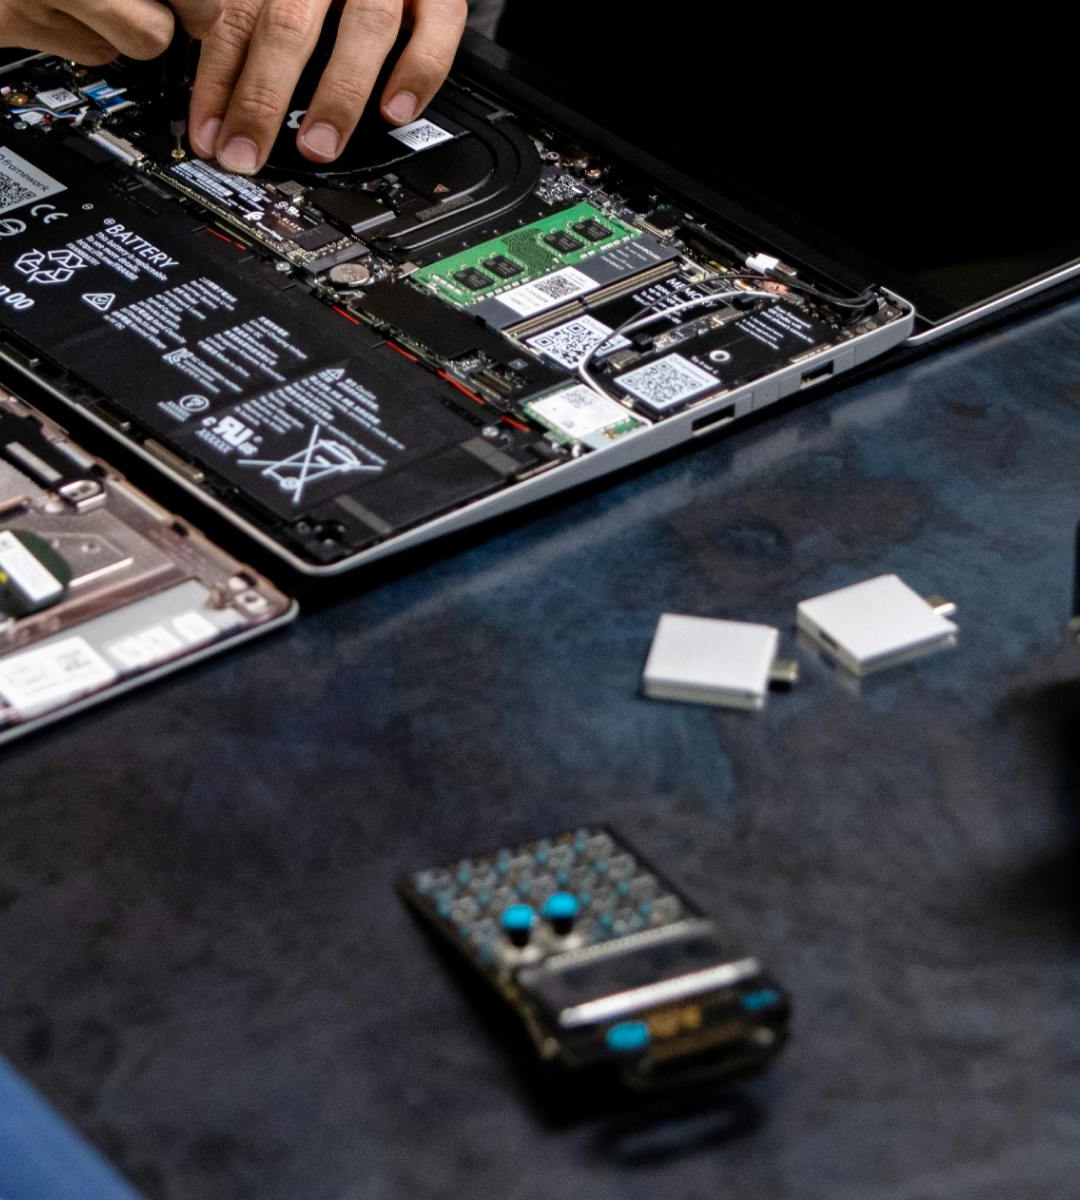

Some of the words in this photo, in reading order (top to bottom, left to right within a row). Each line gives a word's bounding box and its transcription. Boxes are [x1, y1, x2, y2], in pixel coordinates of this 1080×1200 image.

[2, 159, 49, 192] framework
[104, 223, 179, 268] BATTERY
[4, 292, 35, 310] 00
[667, 277, 718, 307] MEMORY
